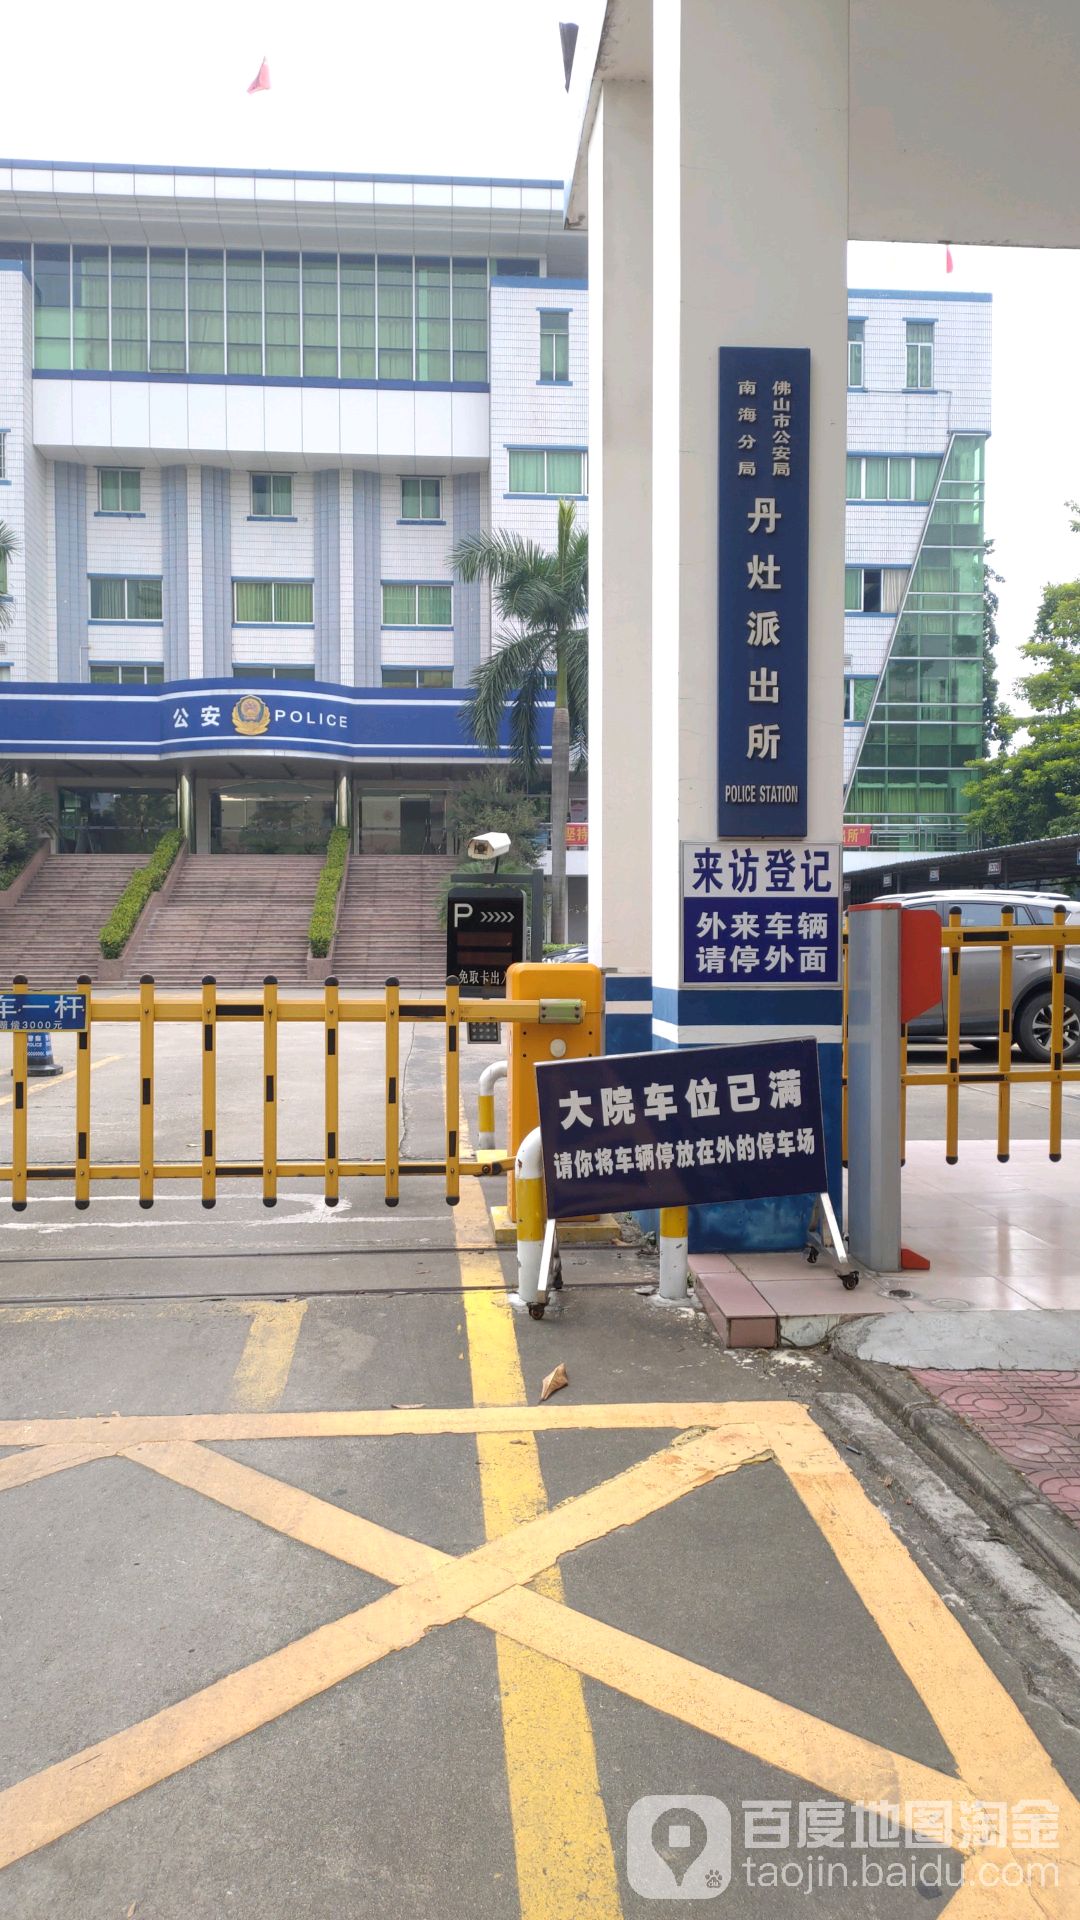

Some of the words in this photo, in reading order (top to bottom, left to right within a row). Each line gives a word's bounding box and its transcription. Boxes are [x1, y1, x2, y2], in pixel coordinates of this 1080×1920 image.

[738, 380, 757, 477] 南海分局
[772, 380, 792, 477] 佛山市公安局
[747, 497, 782, 760] 丹灶派出所
[173, 705, 221, 729] 公安
[274, 709, 348, 729] POLICE
[725, 784, 756, 803] POLICE
[759, 784, 799, 803] STATION
[692, 847, 832, 893] 来访登记
[453, 902, 474, 928] P
[696, 911, 828, 940] 外来车辆
[695, 944, 828, 973] 请停外面
[558, 1068, 803, 1130] 大院车位已满
[553, 1127, 816, 1180] 请你将车辆停放在外的停车场
